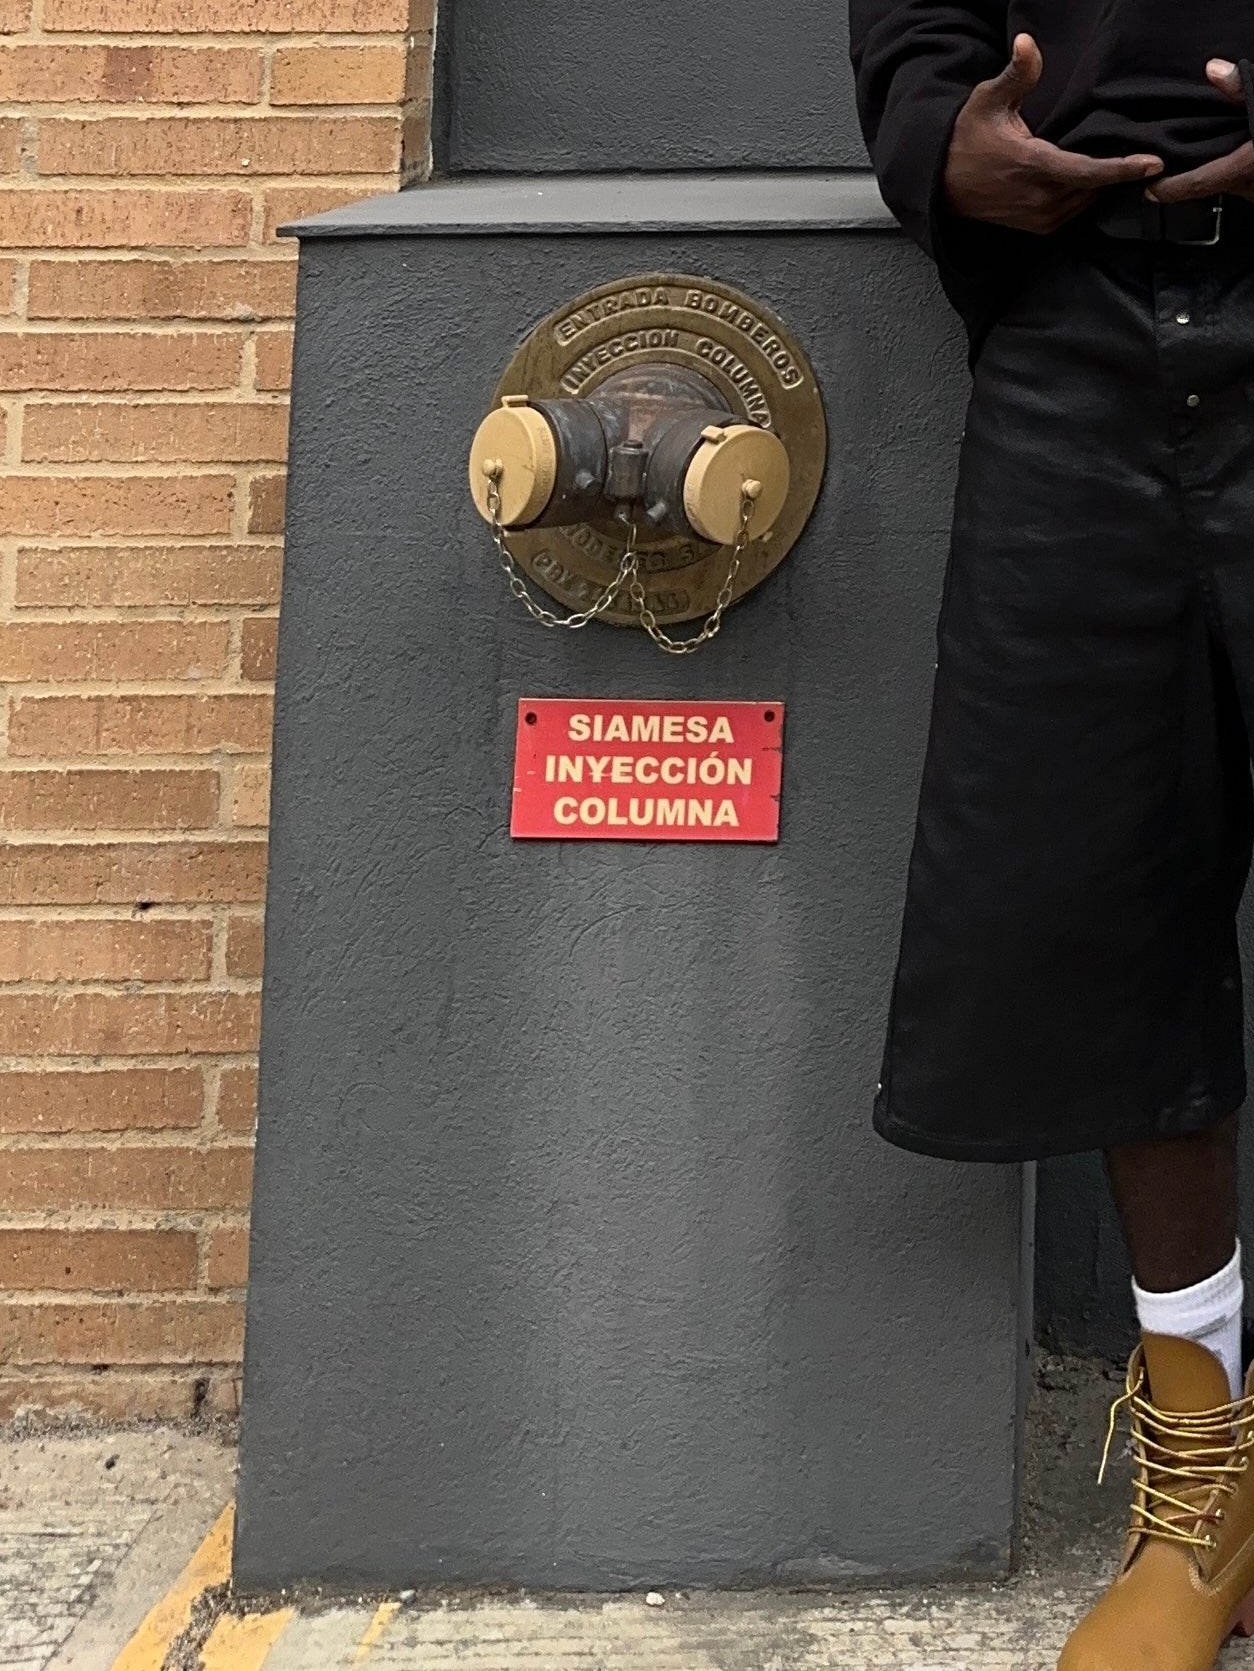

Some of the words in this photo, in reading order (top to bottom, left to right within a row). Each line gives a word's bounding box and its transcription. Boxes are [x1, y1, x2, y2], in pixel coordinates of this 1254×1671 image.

[558, 286, 669, 340] ENTRADA
[685, 289, 800, 385] BOMBEROS
[563, 329, 679, 390] INYECCION
[697, 338, 769, 425] COLUMNA
[568, 714, 734, 743] SIAMESA
[545, 751, 752, 785] INYECCIÓN
[553, 796, 740, 827] COLUMNA
